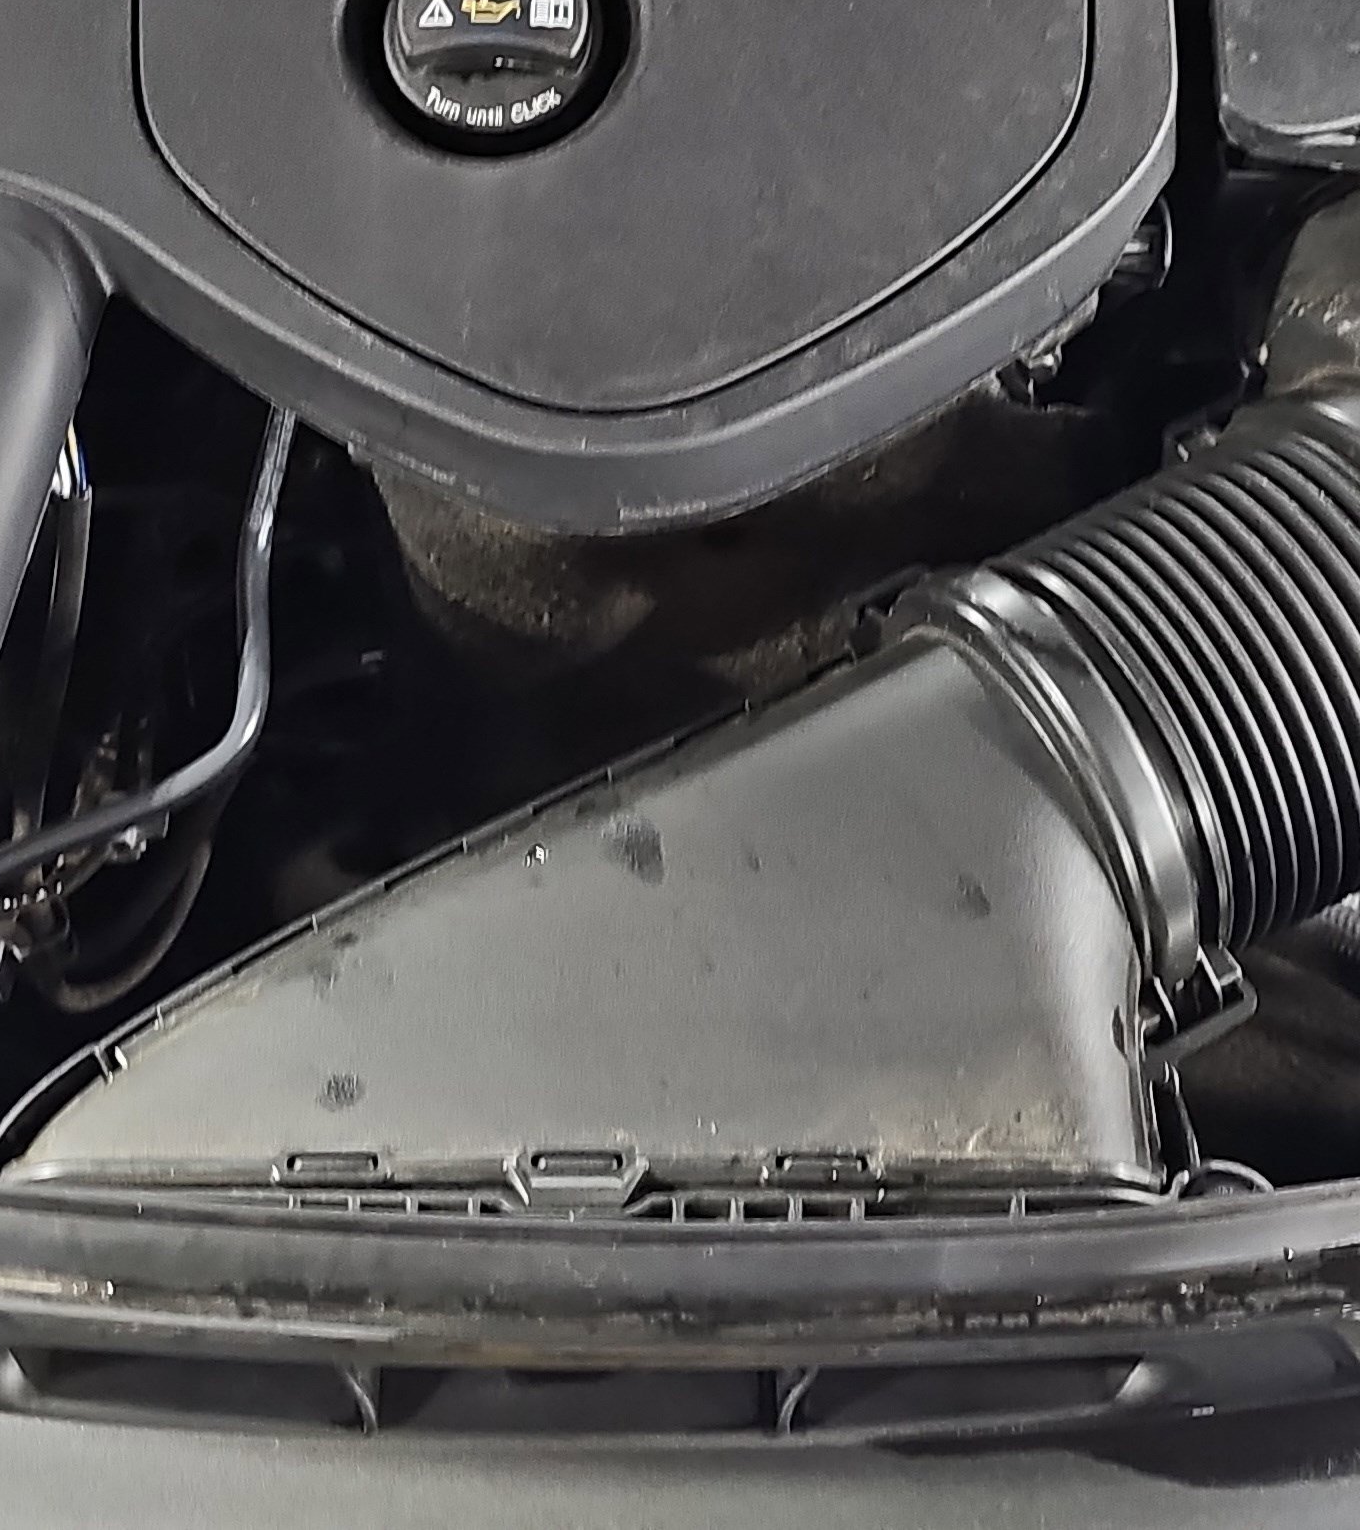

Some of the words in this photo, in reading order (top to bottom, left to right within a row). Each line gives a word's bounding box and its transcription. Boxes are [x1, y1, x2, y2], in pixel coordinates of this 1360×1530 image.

[425, 85, 461, 122] Turn
[467, 105, 503, 127] until
[511, 86, 562, 124] CLICK
